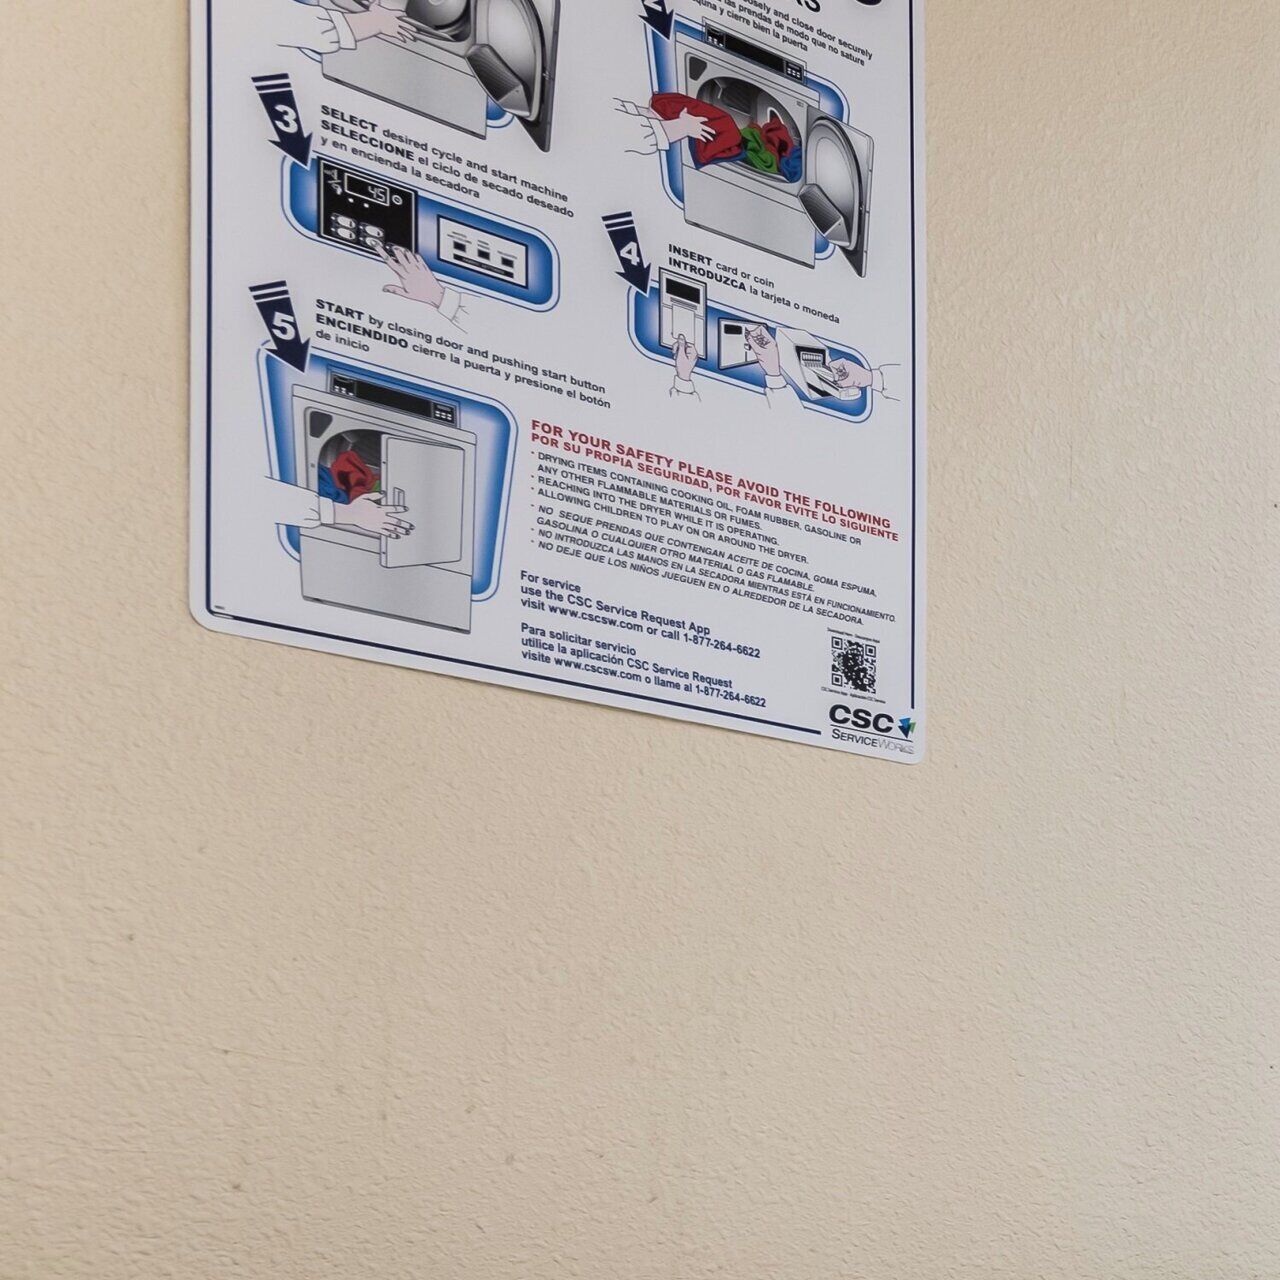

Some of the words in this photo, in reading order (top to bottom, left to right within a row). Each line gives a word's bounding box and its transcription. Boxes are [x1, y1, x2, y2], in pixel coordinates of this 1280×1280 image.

[274, 105, 299, 133] 3
[321, 104, 377, 132] SELECT
[382, 129, 428, 151] desired
[431, 147, 462, 164] cycle
[466, 159, 487, 173] and
[491, 168, 517, 184] start
[520, 179, 567, 202] machine
[321, 137, 327, 146] y
[332, 140, 347, 151] en
[351, 147, 407, 172] encienda
[411, 165, 421, 178] la
[425, 173, 479, 198] secadora
[321, 119, 414, 160] SELECCIONE
[418, 156, 428, 166] el
[432, 161, 460, 177] ciclo
[464, 172, 478, 183] de
[482, 179, 523, 199] secado
[526, 194, 573, 217] deseado
[619, 242, 640, 267] 4
[668, 243, 712, 265] INSERT
[716, 262, 737, 275] card
[740, 271, 750, 279] or
[753, 275, 774, 288] coin
[668, 257, 746, 290] INTRODUZCA
[749, 284, 757, 295] la
[761, 289, 790, 306] tarjeta
[793, 302, 799, 310] o
[802, 305, 839, 323] moneda
[271, 313, 296, 341] 5
[315, 329, 331, 340] de
[335, 333, 369, 352] inicio
[315, 298, 364, 320] START
[368, 314, 383, 329] by
[387, 322, 432, 344] closing
[435, 336, 463, 350] door
[467, 346, 488, 358] and
[492, 354, 538, 375] pushing
[541, 368, 566, 382] start
[570, 375, 605, 393] button
[316, 313, 408, 348] ENCIENDIDO
[412, 344, 446, 360] cierre
[450, 352, 460, 364] la
[464, 359, 500, 376] puerta
[504, 371, 510, 381] y
[514, 374, 563, 394] presione
[566, 389, 576, 398] el
[579, 391, 610, 408] botón
[531, 419, 562, 438] FOR
[568, 429, 611, 451] YOUR
[616, 443, 673, 467] SAFETY
[678, 461, 732, 485] PLEASE
[737, 478, 778, 497] AVOID
[783, 490, 810, 506] THE
[814, 499, 890, 528] FOLLOWING
[531, 432, 558, 448] POR
[563, 441, 580, 454] SU
[585, 447, 633, 468] PROPIA
[637, 462, 714, 492] SEGURIDAD,
[716, 483, 740, 498] POR
[744, 491, 781, 509] FAVOR
[785, 502, 818, 519] EVITE
[822, 510, 836, 524] LO
[840, 515, 898, 541] SIGUIENTE
[537, 463, 557, 475] ANY
[560, 469, 594, 485] OTHER
[597, 479, 656, 502] FLAMMABLE
[659, 496, 711, 516] MATERIALS
[714, 510, 727, 520] OR
[729, 514, 762, 530] FUMES.
[520, 569, 539, 583] For
[542, 577, 580, 593] service
[520, 585, 541, 601] use
[545, 589, 563, 602] the
[567, 593, 592, 608] CSC
[596, 600, 637, 618] Service
[640, 610, 685, 635] Request
[688, 621, 710, 641] App
[520, 597, 545, 611] visit
[548, 605, 643, 631] www.cscsw.com
[646, 626, 657, 635] or
[661, 629, 679, 640] call
[683, 632, 760, 658] 1-877-264-6622
[829, 704, 895, 733] CSC
